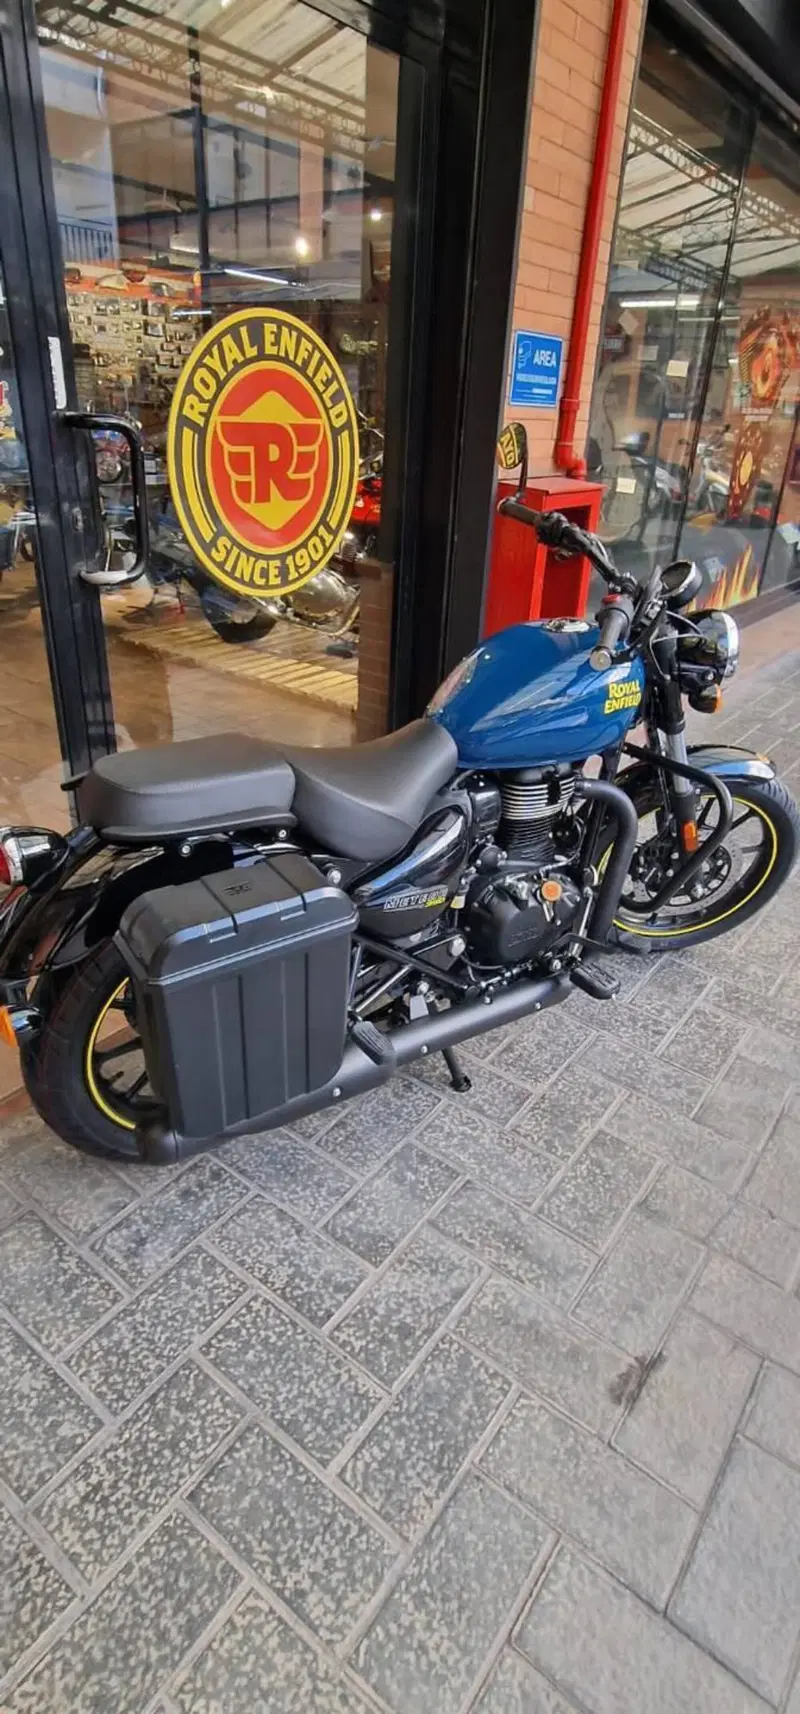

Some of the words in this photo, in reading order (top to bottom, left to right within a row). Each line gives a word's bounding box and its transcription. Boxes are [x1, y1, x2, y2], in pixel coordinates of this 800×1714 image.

[533, 349, 557, 368] AREA
[183, 325, 258, 428] ROYAL
[263, 322, 349, 430] ENFIELD
[210, 535, 282, 587] SINCE
[285, 524, 335, 581] 1901
[608, 679, 640, 699] ROYAL
[604, 691, 642, 715] ENFIELD
